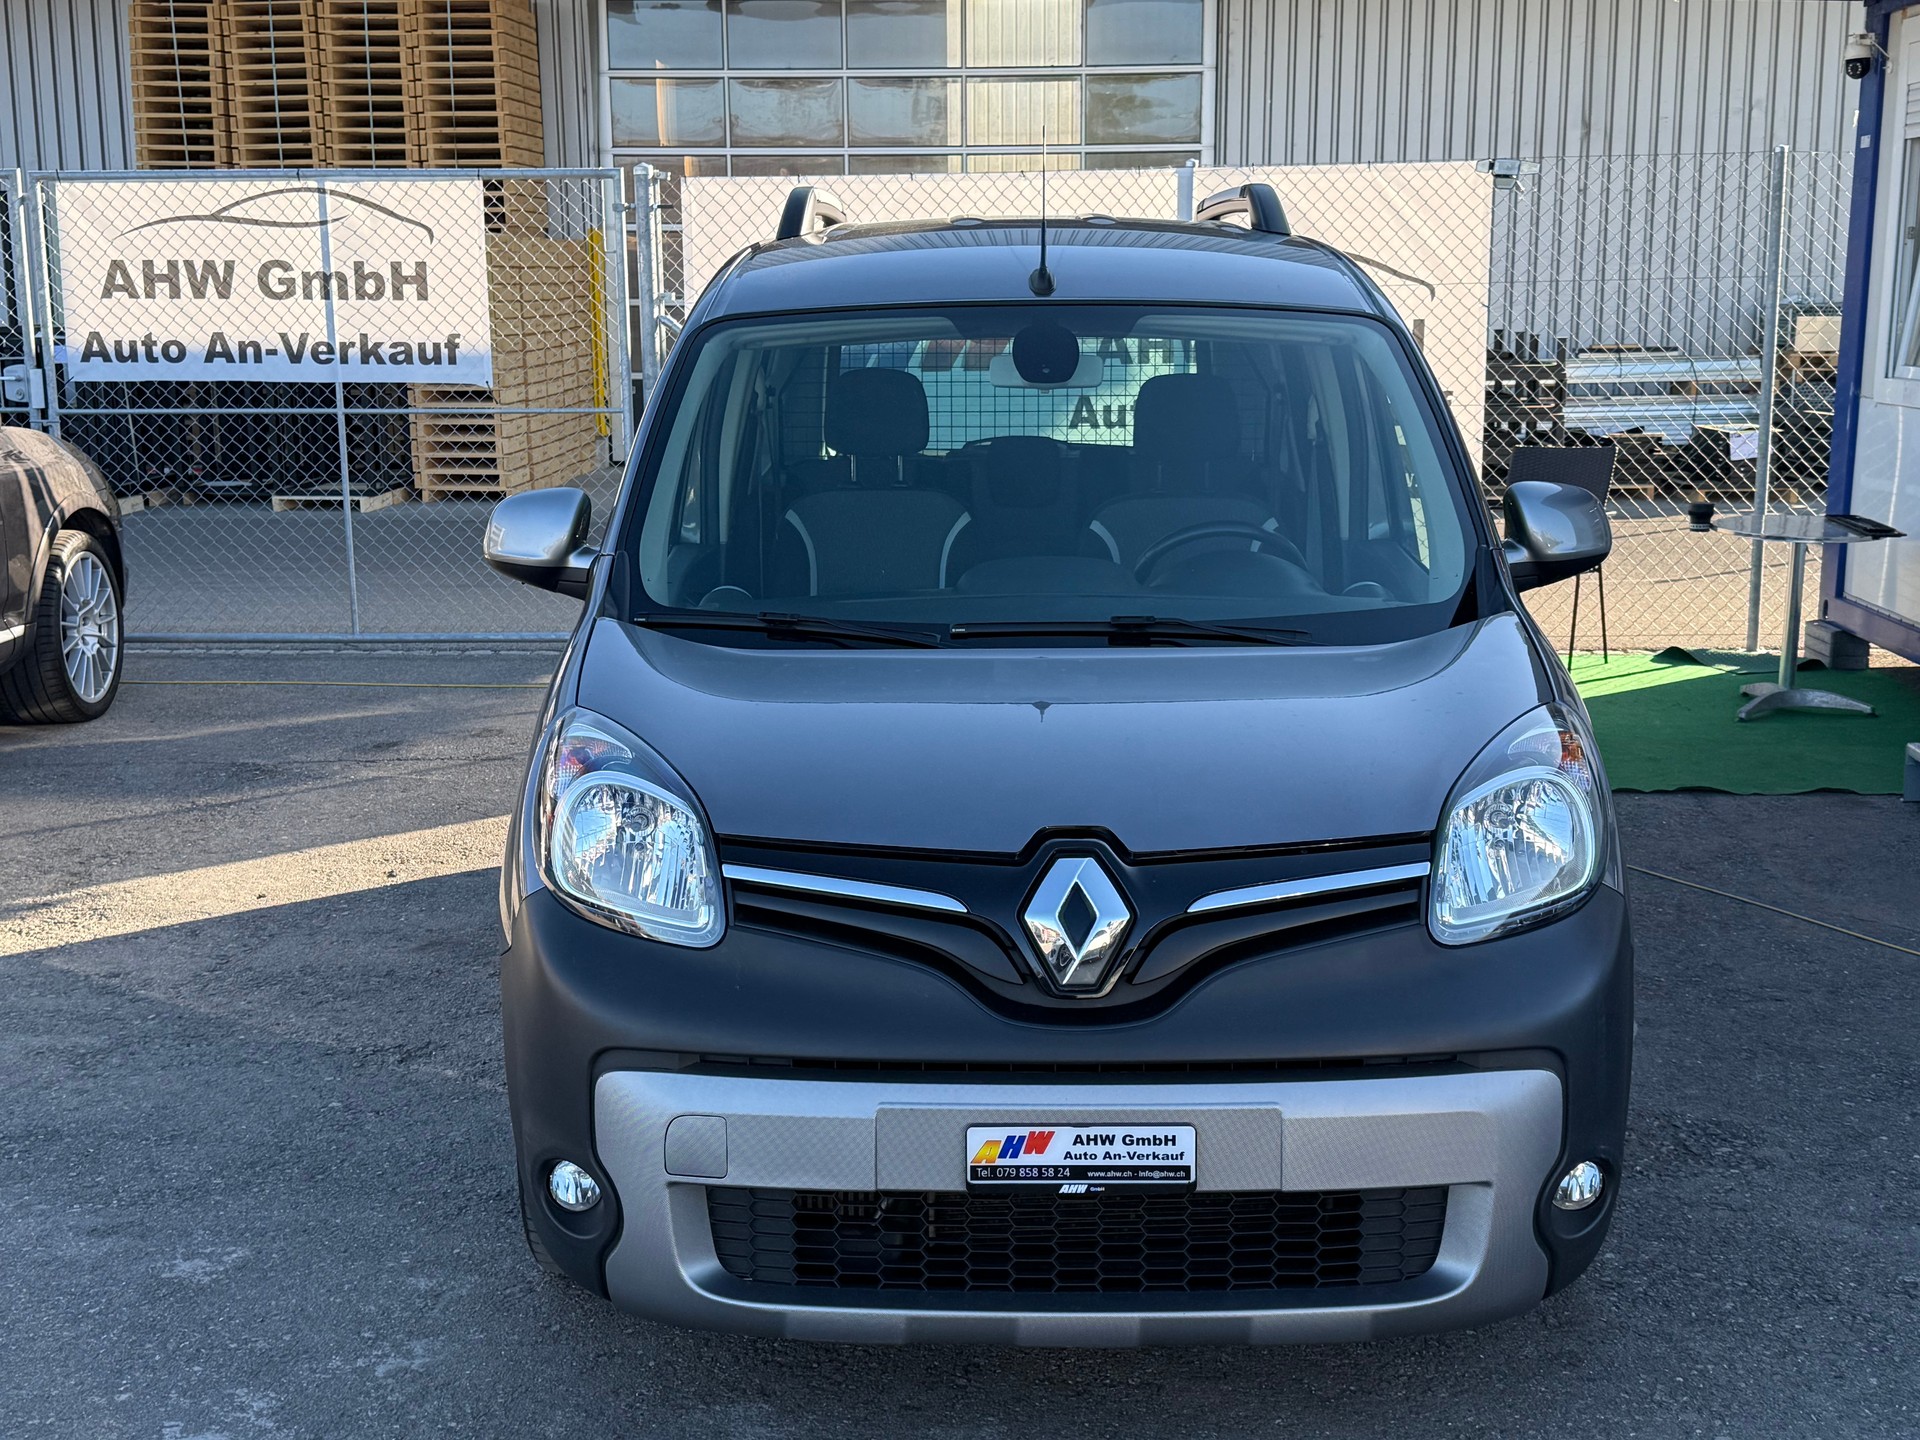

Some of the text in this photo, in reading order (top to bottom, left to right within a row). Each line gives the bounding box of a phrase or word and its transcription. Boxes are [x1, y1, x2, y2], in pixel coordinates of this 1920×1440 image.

[101, 260, 430, 302] AHW GmbH
[80, 331, 461, 367] Auto An-Verkauf
[1068, 394, 1138, 430] Au
[970, 1131, 1056, 1164] AHW
[1072, 1134, 1177, 1147] AHW GmbH
[1063, 1151, 1185, 1161] Auto An-Verkauf
[976, 1167, 994, 1178] Tel.
[996, 1167, 1016, 1178] 079
[1019, 1167, 1039, 1178] 858
[1041, 1167, 1055, 1178] 58
[1057, 1167, 1070, 1178] 24
[1087, 1170, 1133, 1178] www.ahw.ch
[1138, 1170, 1186, 1179] info@ahw.ch
[1059, 1184, 1088, 1194] AHW
